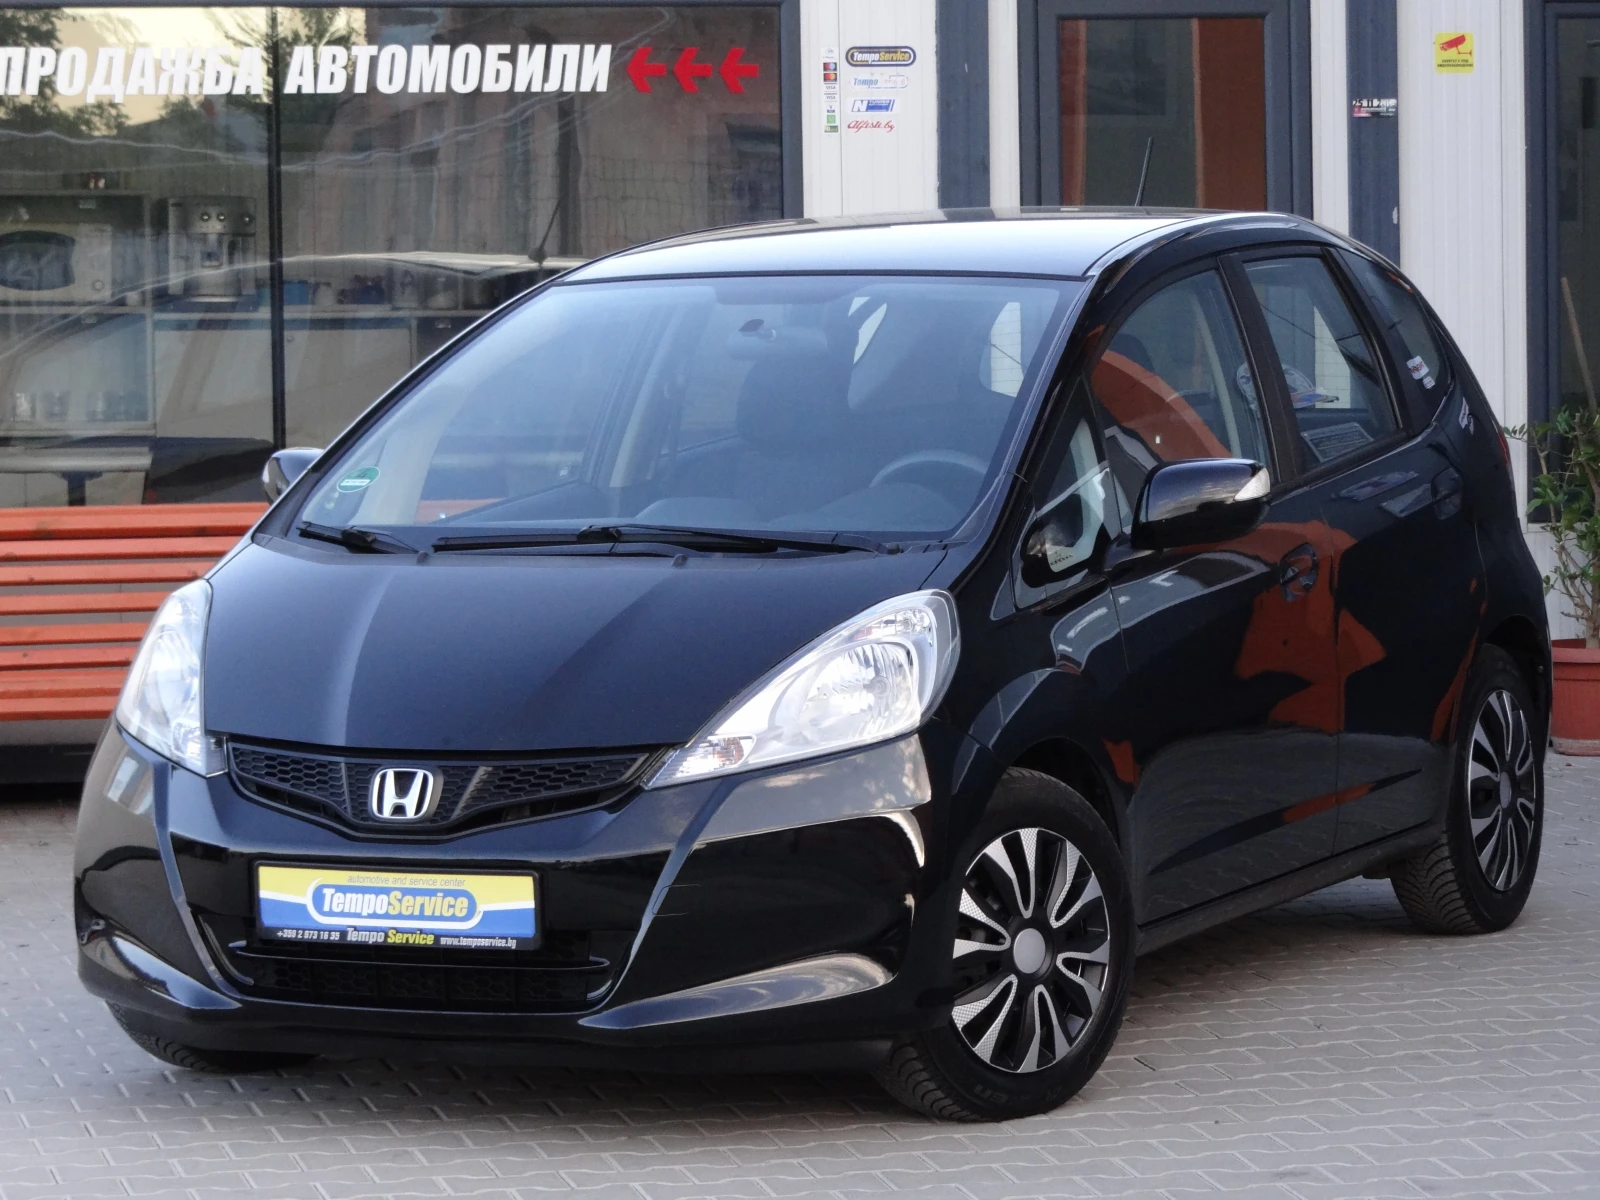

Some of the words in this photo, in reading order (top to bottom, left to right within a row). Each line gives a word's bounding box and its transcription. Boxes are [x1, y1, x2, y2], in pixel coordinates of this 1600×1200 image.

[0, 46, 263, 103] ПРОДАЖБА
[283, 44, 612, 94] АВТОМОБИЛИ
[347, 875, 390, 886] automotive
[392, 877, 407, 886] and
[408, 878, 438, 887] service
[322, 888, 469, 917] TempoService
[277, 930, 297, 939] +359
[298, 930, 303, 939] 2
[330, 932, 340, 941] 35
[346, 927, 386, 944] Tempo
[387, 929, 434, 944] Service
[440, 936, 517, 949] www.temposervice.bg
